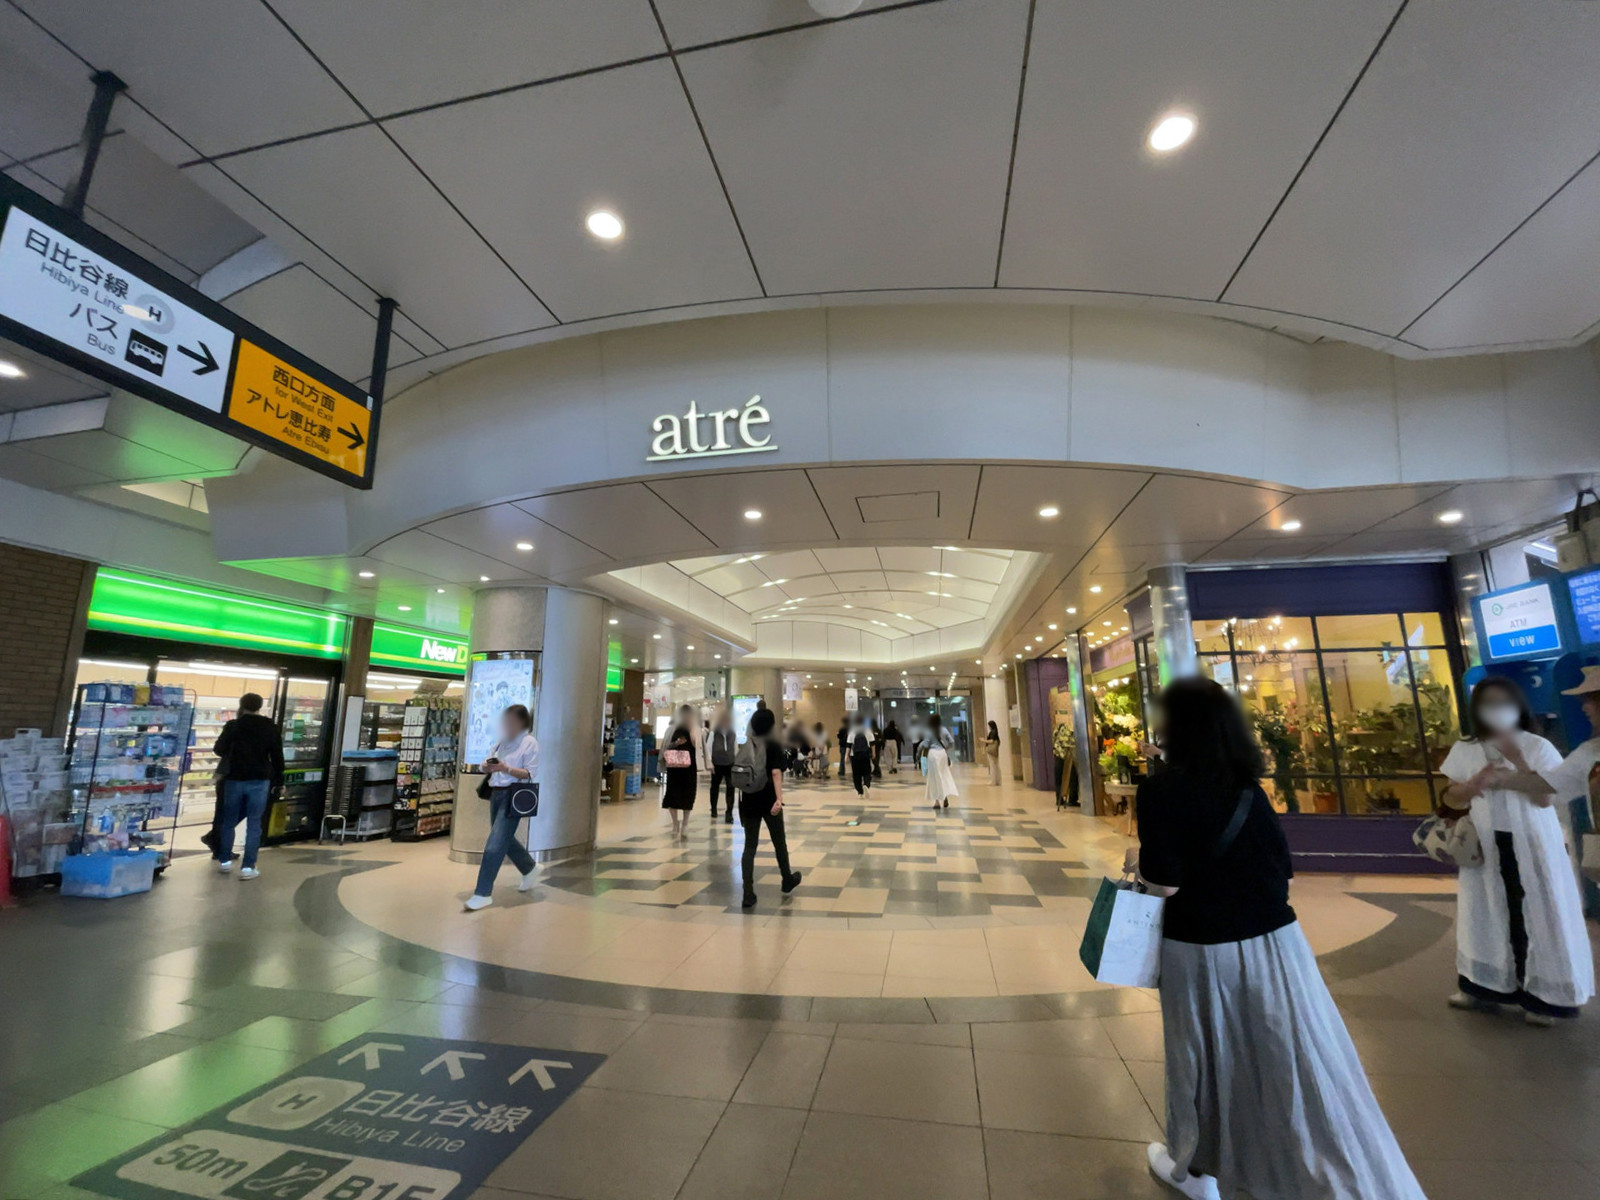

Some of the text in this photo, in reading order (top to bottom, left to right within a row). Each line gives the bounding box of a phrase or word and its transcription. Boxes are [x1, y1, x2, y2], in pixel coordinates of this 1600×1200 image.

[25, 228, 129, 300] 日比谷線
[41, 262, 125, 315] Hibiya Line
[69, 303, 118, 340] バス
[149, 306, 162, 322] H
[87, 333, 115, 355] Bus
[273, 365, 336, 412] 西口方面
[275, 386, 333, 422] for West Exit
[247, 388, 332, 443] アトレ恵比寿
[652, 394, 772, 456] atré
[1510, 617, 1527, 628] ATM
[277, 1093, 318, 1110] H
[343, 1090, 533, 1134] 日比谷線
[312, 1118, 466, 1153] Hibiya Line
[153, 1144, 249, 1180] 50m
